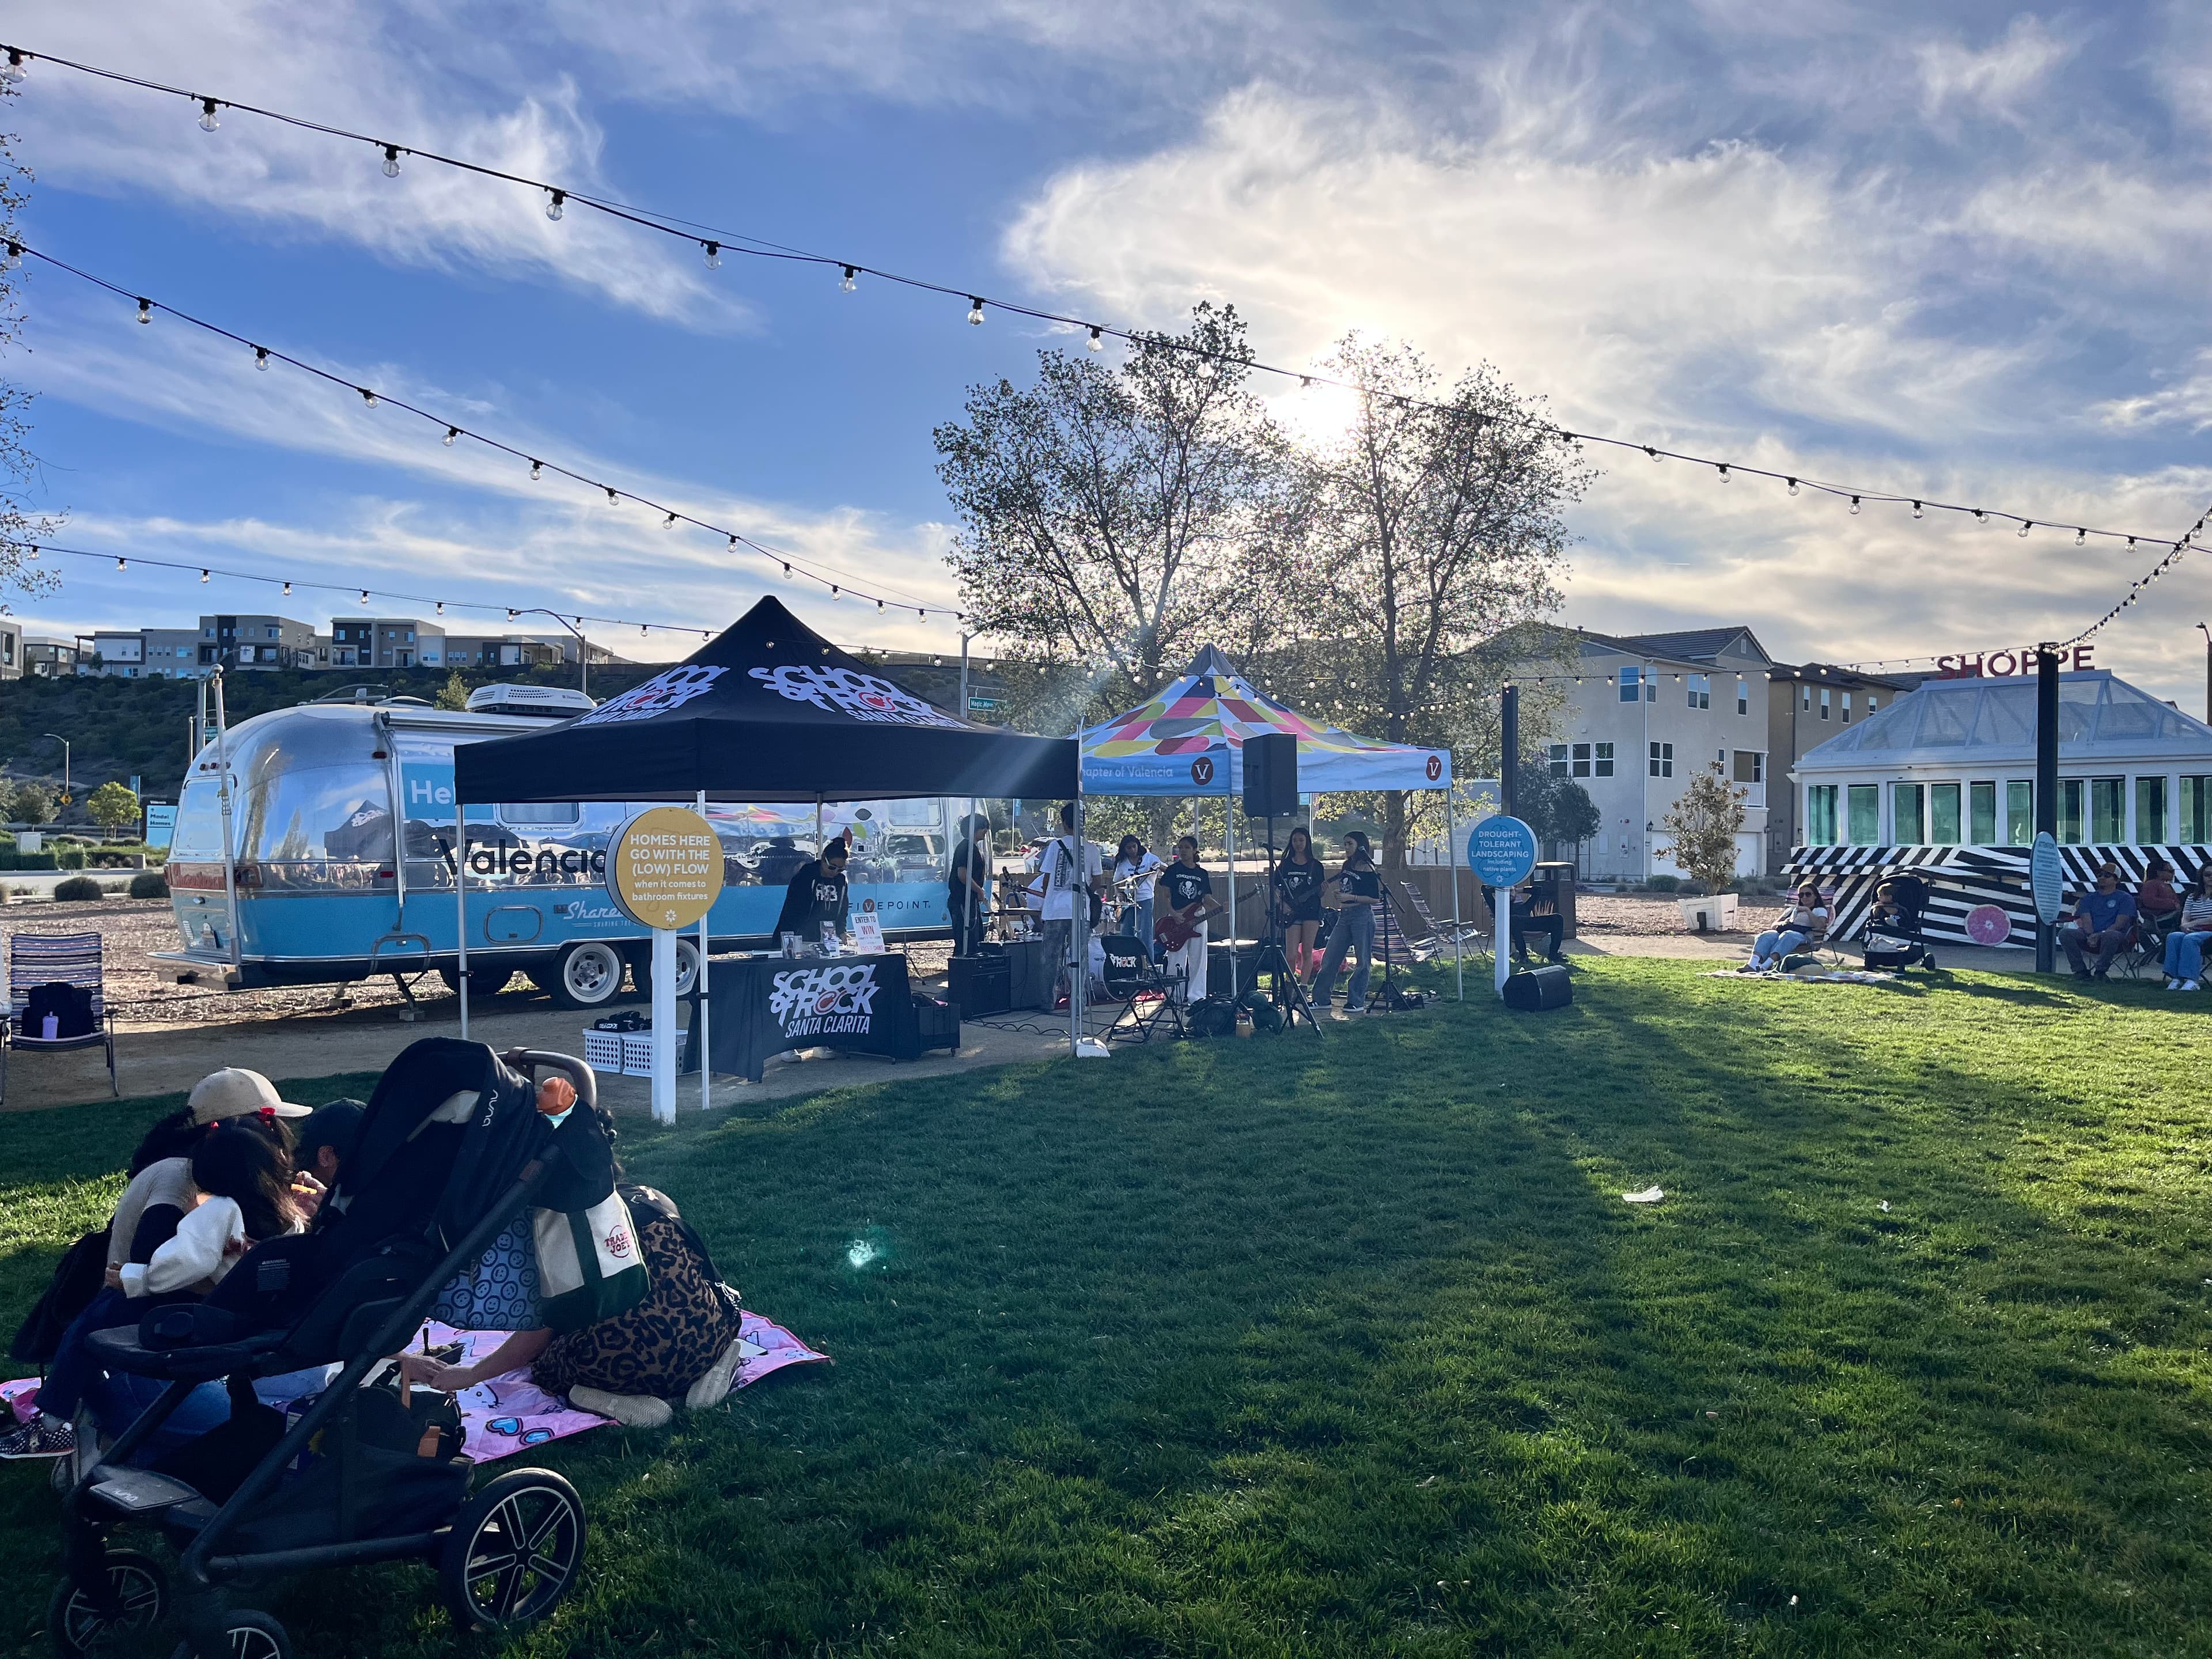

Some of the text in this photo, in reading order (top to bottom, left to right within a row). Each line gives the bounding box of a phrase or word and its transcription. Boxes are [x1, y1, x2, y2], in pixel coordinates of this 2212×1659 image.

[748, 666, 908, 698] SCHOOL
[822, 689, 955, 721] ROCK
[845, 710, 912, 724] SANTA
[1115, 766, 1124, 777] of
[1127, 766, 1173, 777] Valencia
[631, 835, 710, 846] HOMES HERE
[438, 839, 607, 875] Valencia
[630, 849, 710, 860] GO WITH THE
[632, 863, 709, 877] (LOW) FLOW
[677, 892, 708, 900] fixtures
[861, 926, 875, 934] WIN
[1116, 956, 1137, 968] ROCK
[773, 964, 876, 995] SCHOOL
[793, 986, 880, 1019] ROCK
[785, 1015, 870, 1038] SANTA CLARITA
[604, 1232, 627, 1247] TRADE
